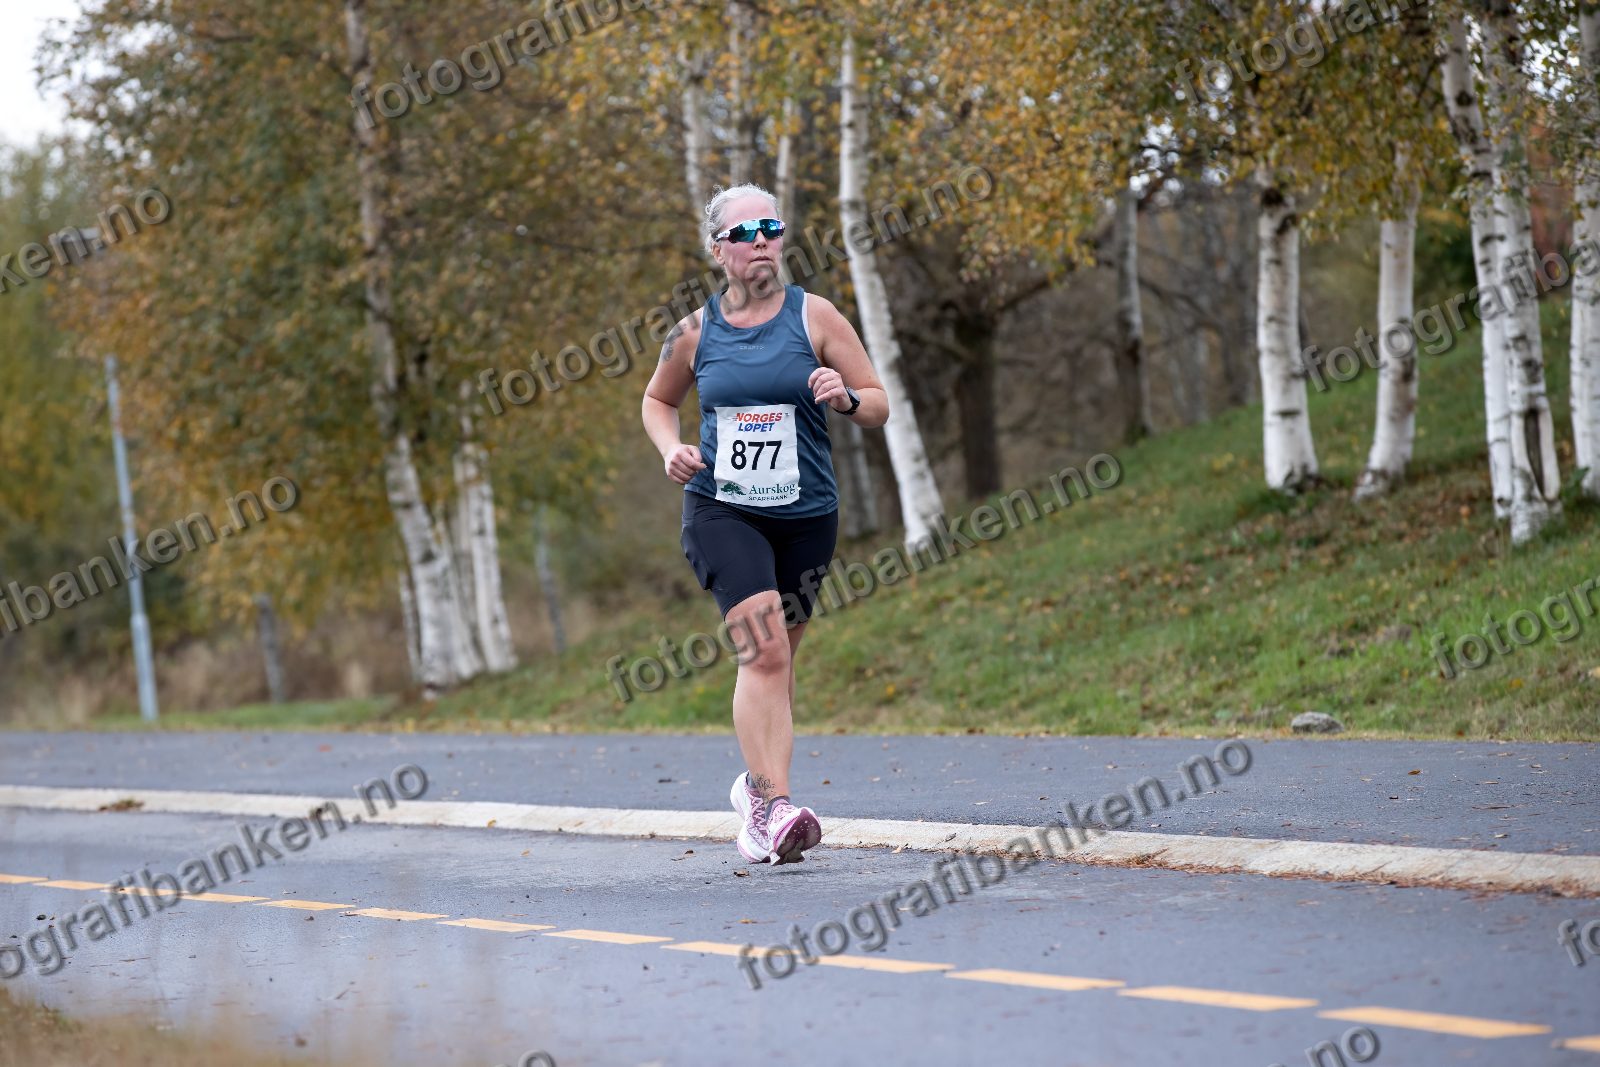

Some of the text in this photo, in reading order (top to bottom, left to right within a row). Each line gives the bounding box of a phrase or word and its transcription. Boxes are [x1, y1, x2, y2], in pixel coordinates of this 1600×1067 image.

[736, 412, 783, 423] NORGES
[738, 422, 775, 432] LØPET
[731, 440, 782, 470] 877
[749, 483, 796, 495] Aurskog
